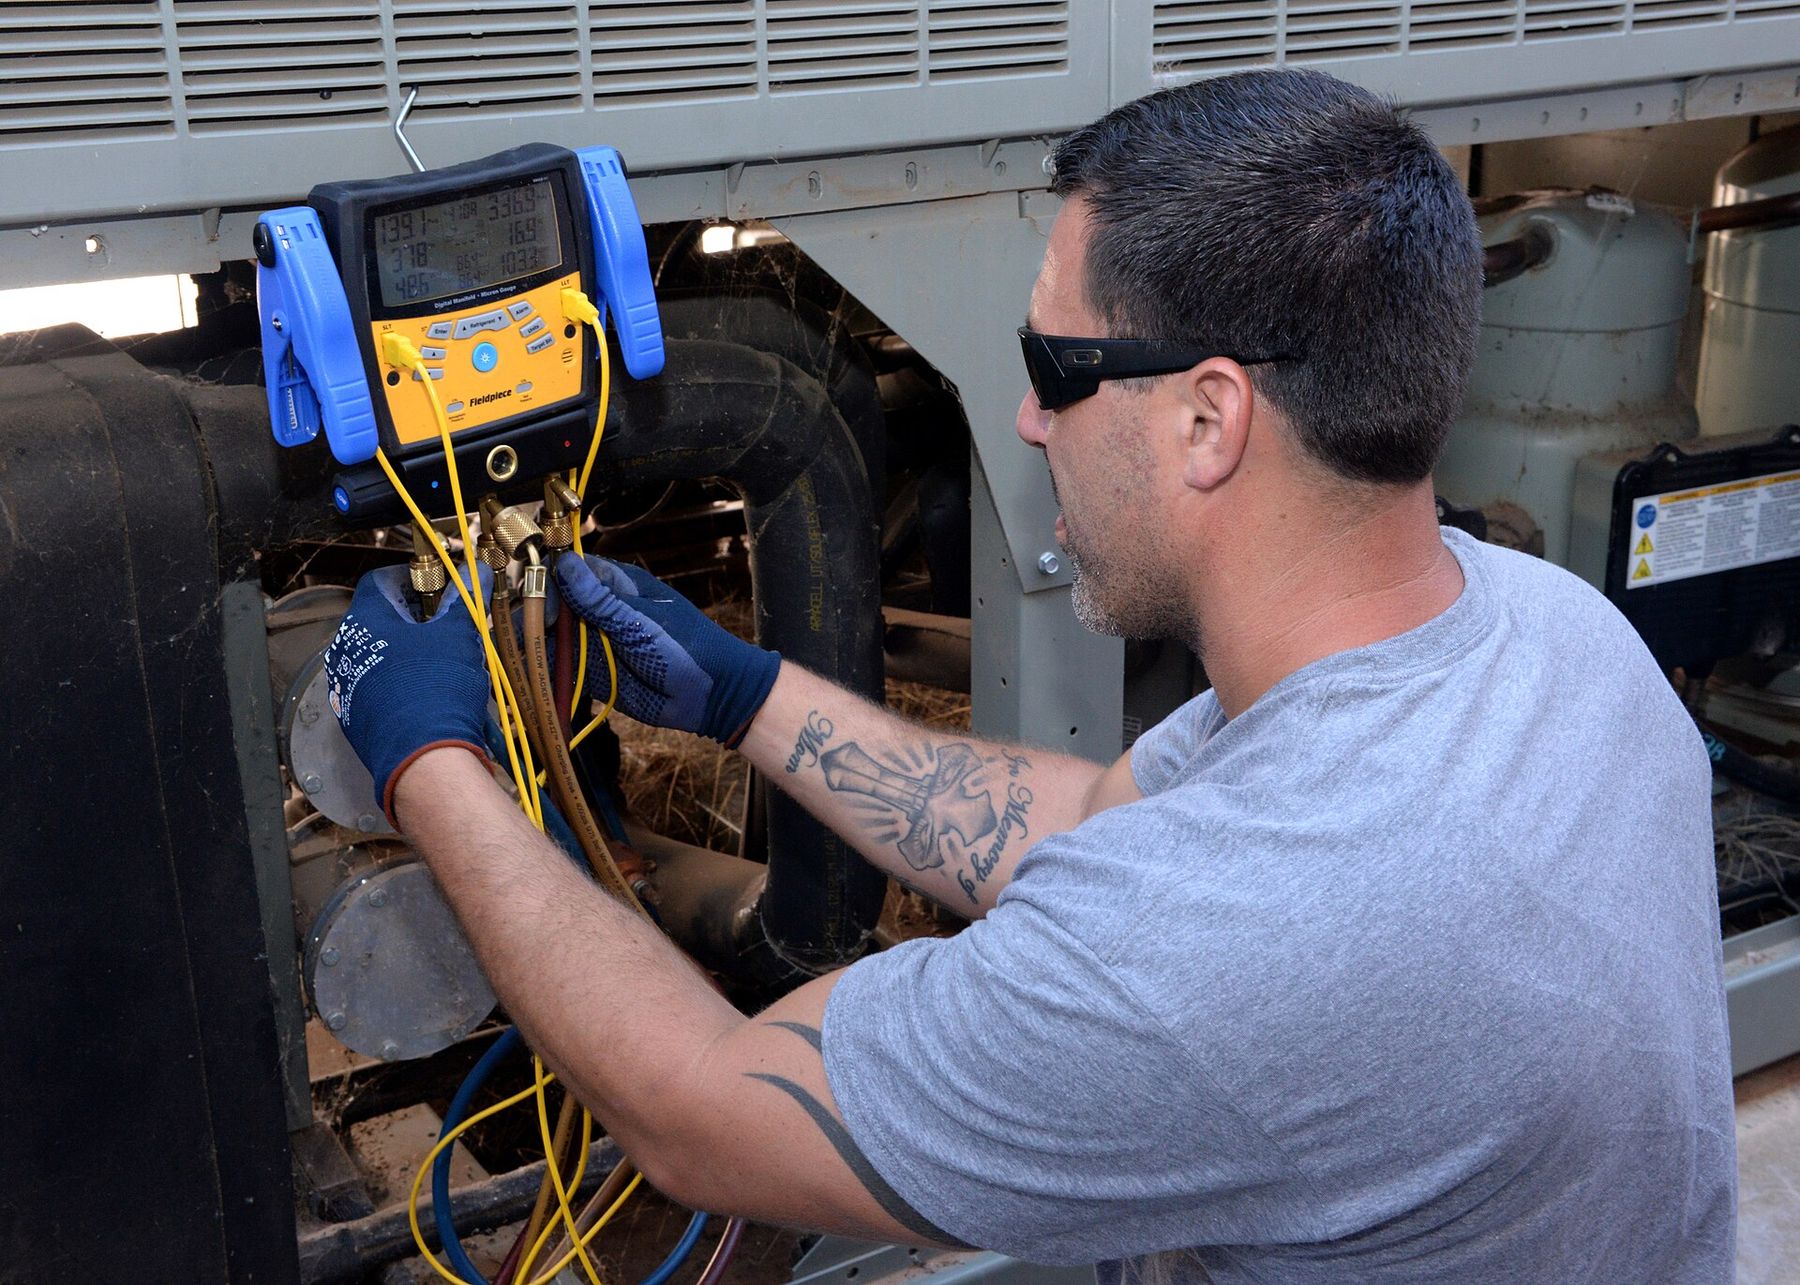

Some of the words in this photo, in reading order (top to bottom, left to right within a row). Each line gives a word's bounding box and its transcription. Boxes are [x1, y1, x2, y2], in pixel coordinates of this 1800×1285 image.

[434, 299, 453, 309] Digital
[453, 294, 476, 304] Manifold
[480, 288, 499, 297] Micron
[499, 285, 517, 294] Gauge
[469, 318, 496, 328] Refrigerant
[515, 306, 529, 315] Alarm
[527, 325, 540, 334] Units
[469, 389, 512, 407] Fieldpiece
[534, 636, 542, 669] YELLOW
[786, 710, 834, 775] Mom
[1001, 749, 1033, 778] In
[970, 782, 1034, 884] Memory
[957, 869, 979, 905] of
